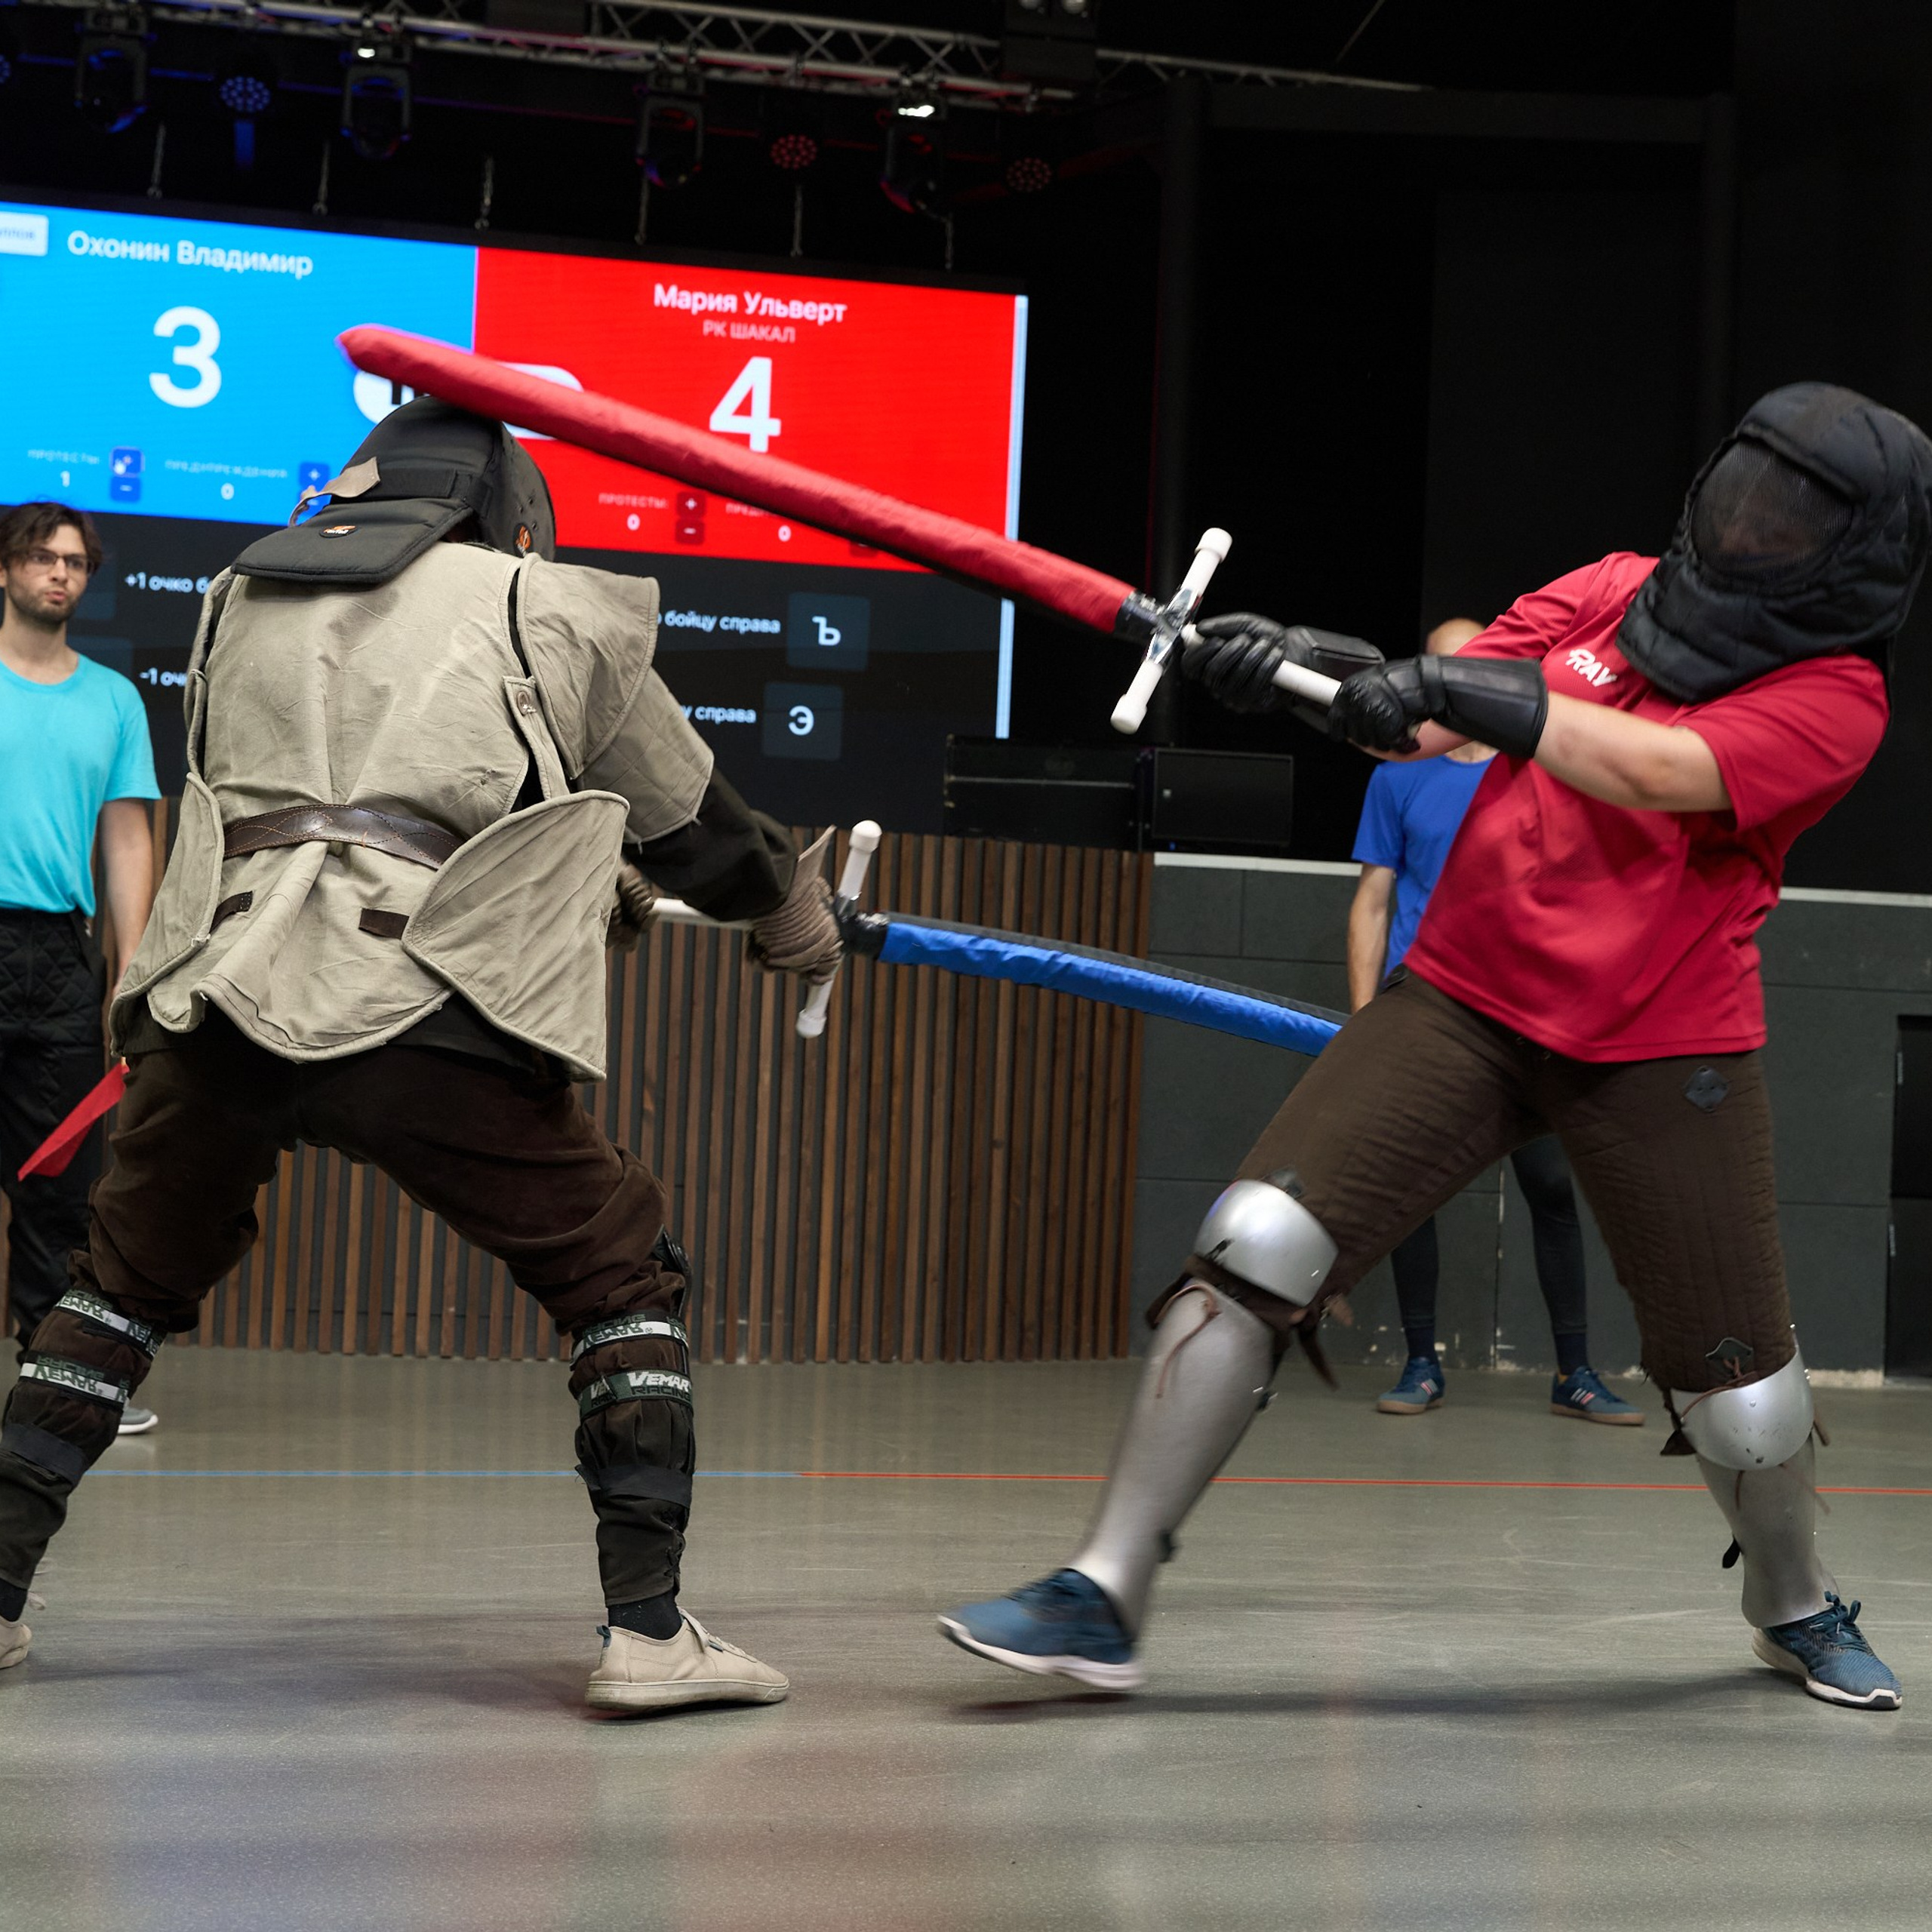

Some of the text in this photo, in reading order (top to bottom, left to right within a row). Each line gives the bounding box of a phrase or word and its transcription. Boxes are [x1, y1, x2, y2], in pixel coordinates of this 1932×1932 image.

[68, 229, 314, 280] Охонин Владимир
[654, 283, 848, 326] Мария Ульверт
[703, 319, 796, 343] РК ШАКАЛ
[149, 305, 222, 408] 3
[709, 356, 781, 453] 4
[60, 470, 71, 488] 1
[220, 482, 235, 500] 0
[626, 513, 640, 531] 0
[778, 525, 792, 543] 0
[148, 576, 194, 593] очко
[665, 609, 717, 632] бойцу
[719, 615, 782, 635] справа
[812, 615, 841, 646] Ъ
[694, 705, 757, 724] справа
[789, 705, 815, 736] Э
[626, 1371, 691, 1392] VEMAR
